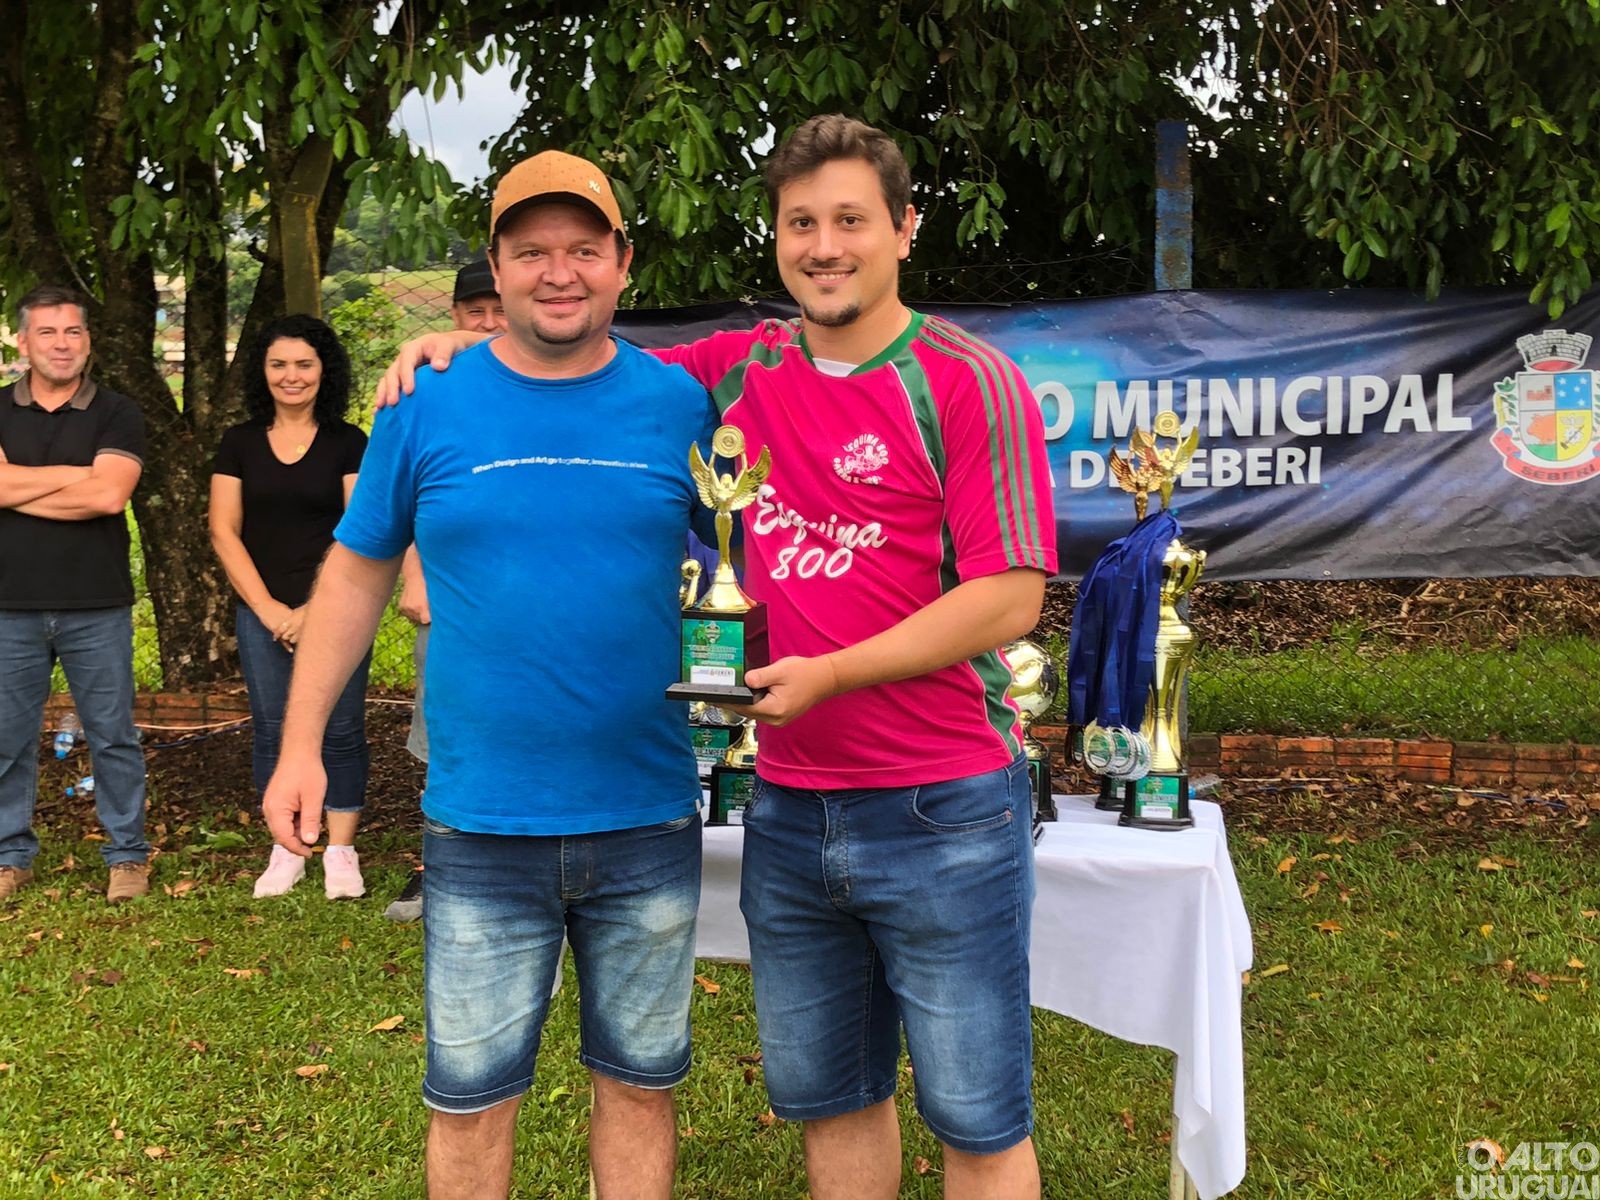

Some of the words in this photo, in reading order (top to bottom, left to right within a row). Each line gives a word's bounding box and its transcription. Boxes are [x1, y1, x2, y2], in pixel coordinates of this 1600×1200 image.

[1092, 373, 1472, 439] MUNICIPAL
[494, 459, 520, 467] Design
[1170, 446, 1322, 488] EBERI
[1520, 464, 1596, 481] SEBERI
[770, 546, 853, 580] 800
